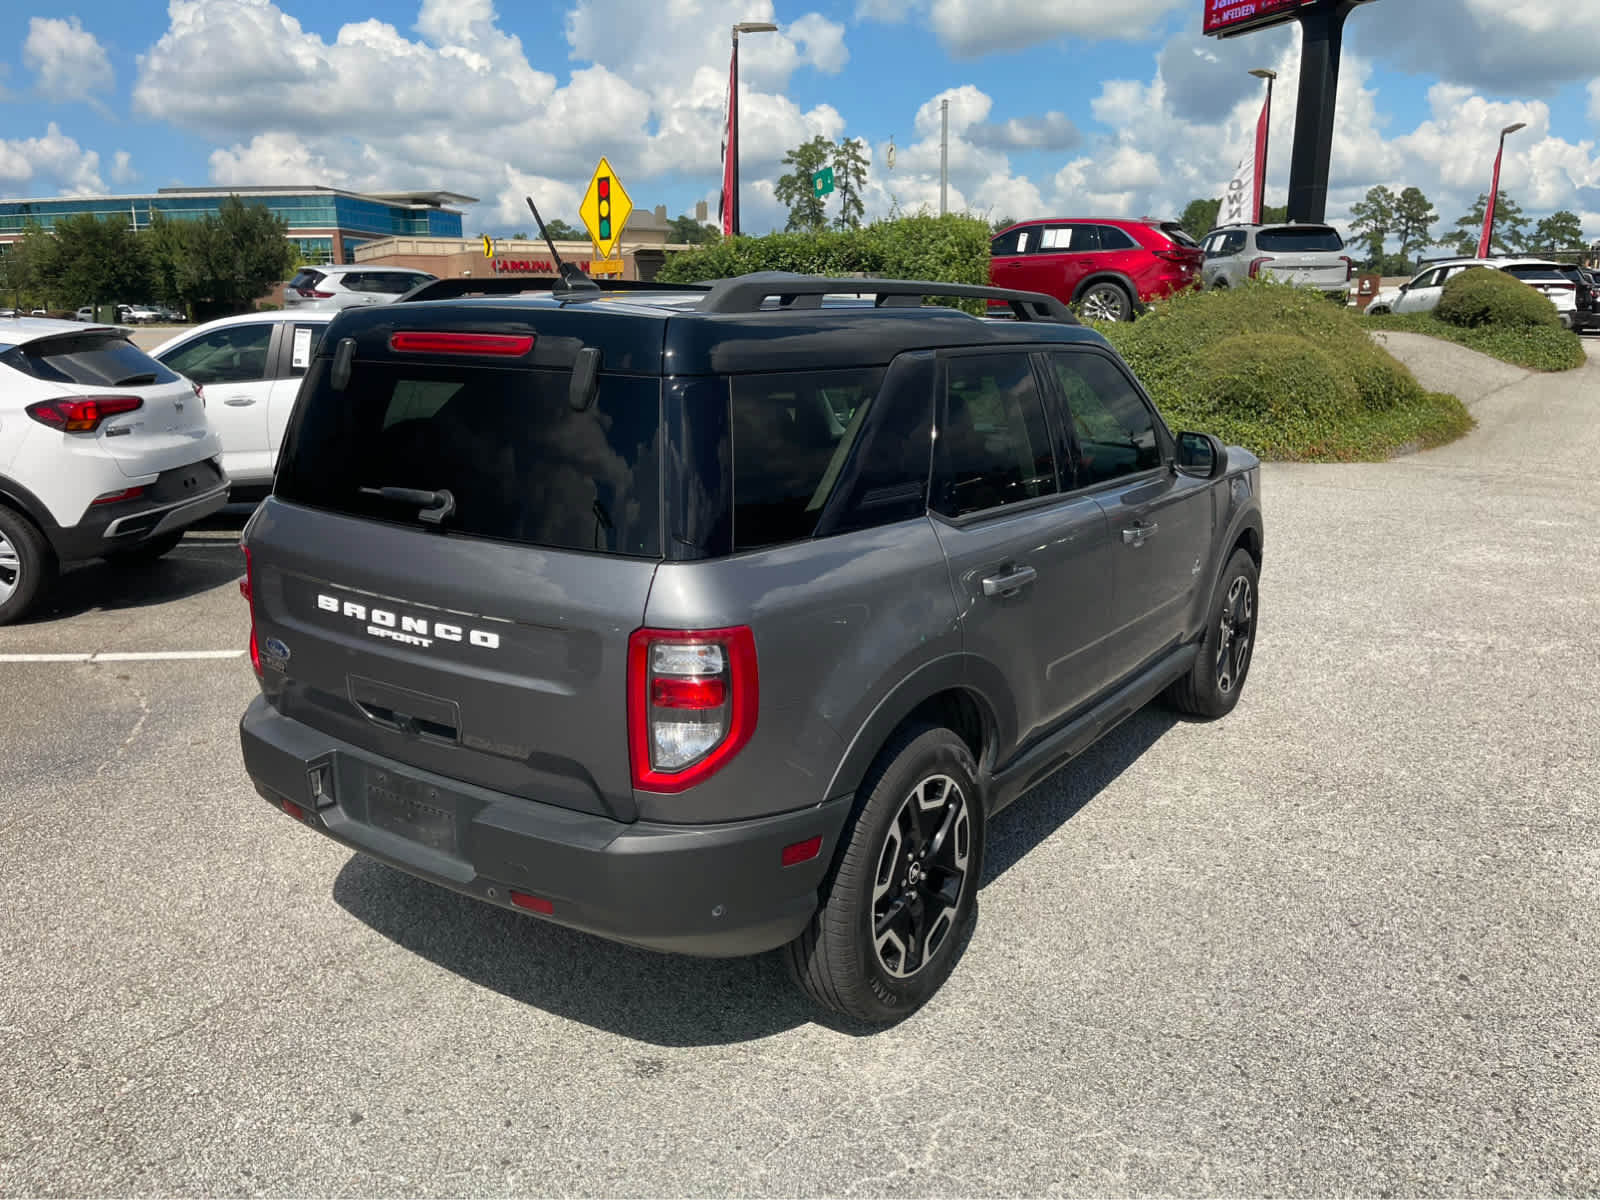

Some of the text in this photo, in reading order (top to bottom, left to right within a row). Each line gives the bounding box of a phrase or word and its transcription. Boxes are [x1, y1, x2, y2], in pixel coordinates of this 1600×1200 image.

[491, 259, 553, 273] CAROLINA
[318, 594, 500, 649] BRONCO
[367, 625, 433, 648] SPORT
